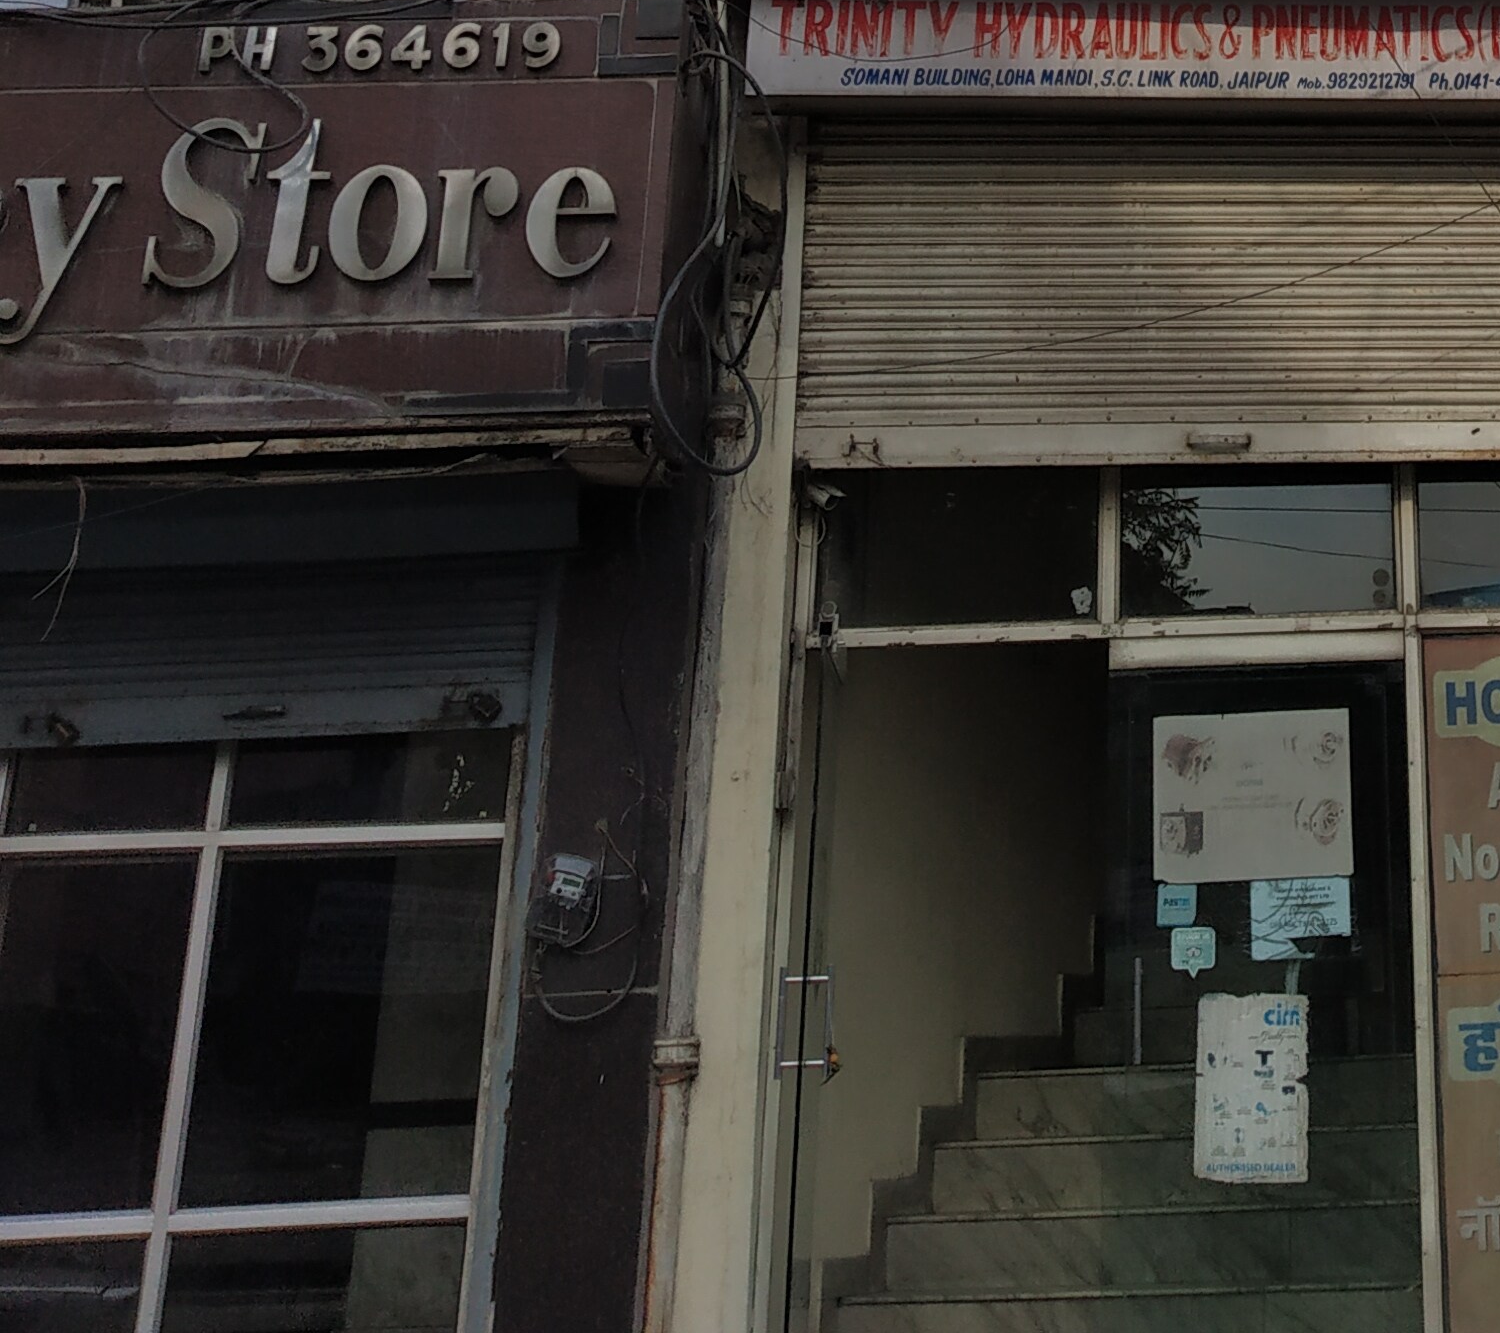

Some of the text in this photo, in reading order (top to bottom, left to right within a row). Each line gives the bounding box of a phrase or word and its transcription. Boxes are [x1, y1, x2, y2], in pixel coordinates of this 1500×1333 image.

[199, 21, 562, 72] PH 364619
[972, 1, 1213, 61] HYDRAULICS
[1218, 3, 1242, 61] &
[840, 67, 910, 87] SOMANI
[913, 68, 995, 89] BUILDING,
[996, 68, 1036, 87] LOHA
[1040, 69, 1098, 89] MANDI,
[1137, 70, 1175, 89] LINK
[1227, 71, 1290, 90] JAIPUR
[0, 116, 618, 344] y Store
